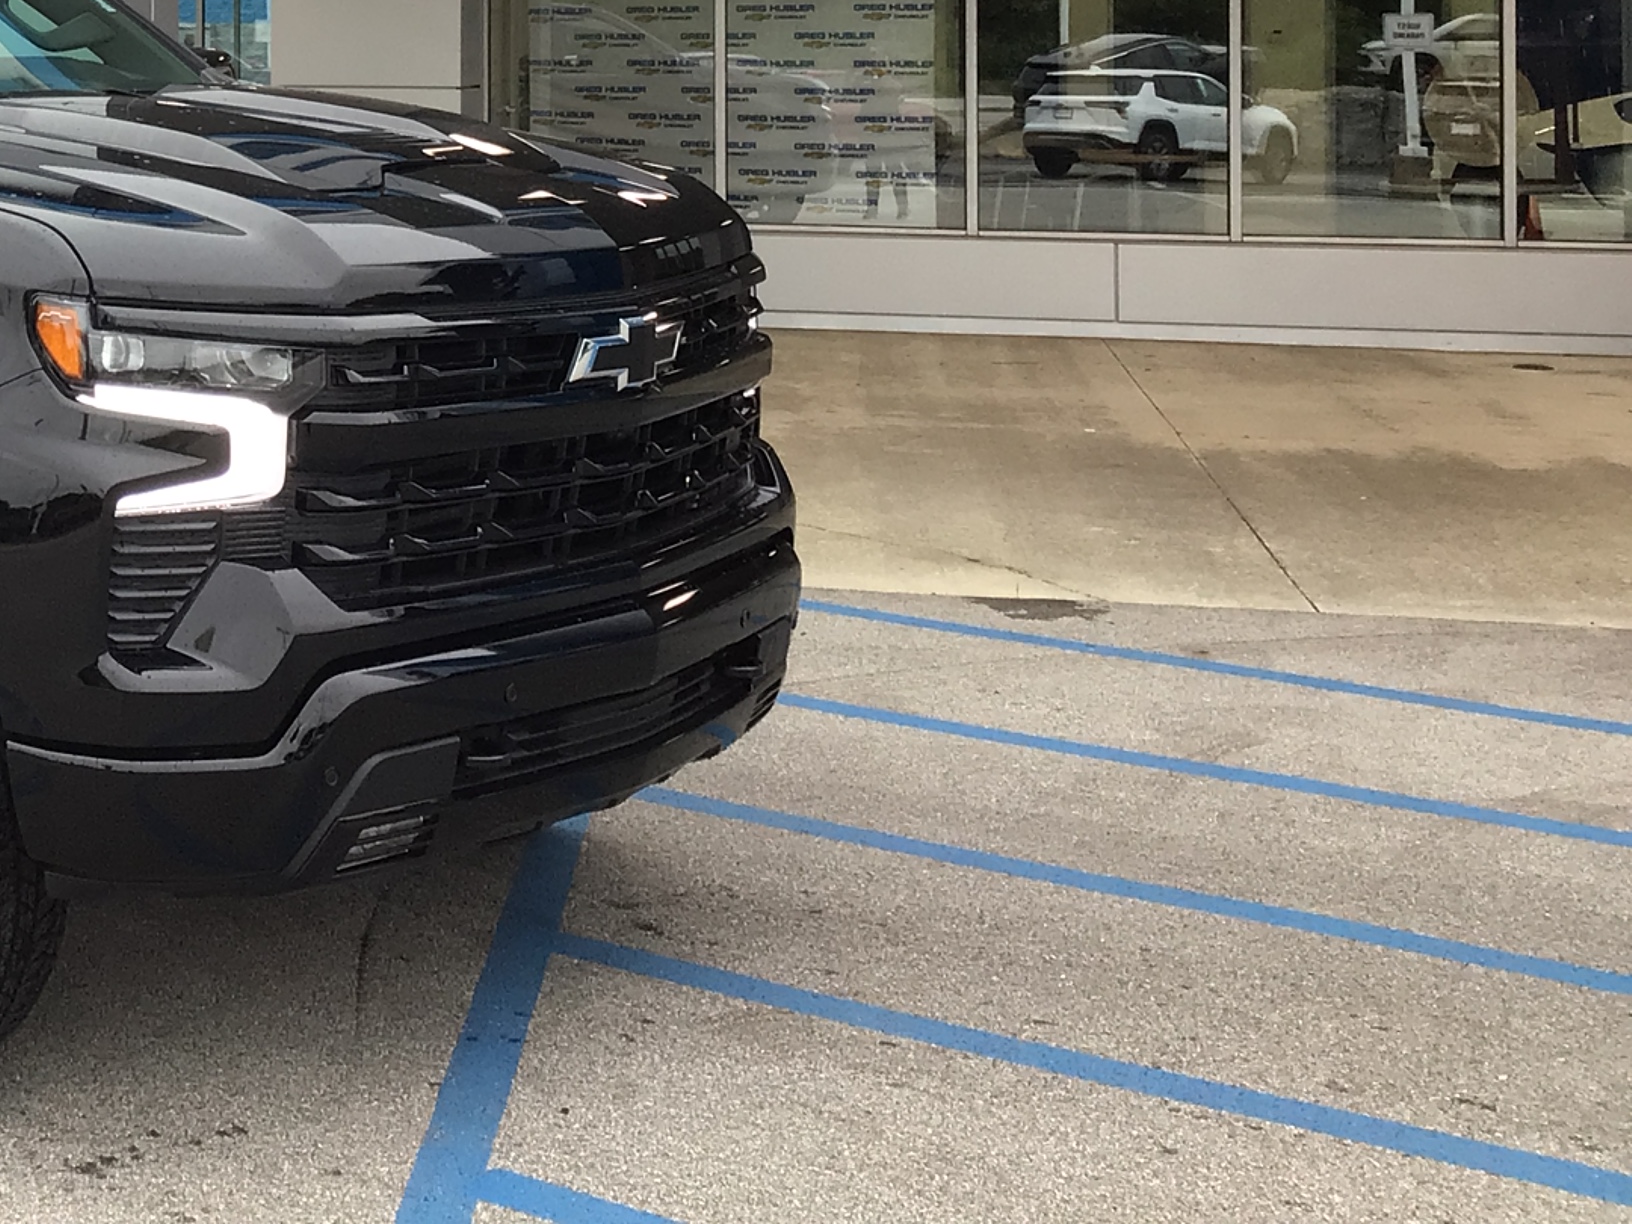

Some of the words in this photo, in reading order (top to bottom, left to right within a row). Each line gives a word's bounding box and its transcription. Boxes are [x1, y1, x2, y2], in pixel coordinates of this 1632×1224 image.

[736, 5, 766, 13] GREG
[770, 4, 814, 12] HUBLER
[854, 3, 885, 11] GREG
[727, 32, 757, 40] BLER
[854, 60, 885, 68] GREG
[771, 115, 815, 123] HUBLER
[727, 141, 756, 149] BLER
[829, 143, 875, 151] HUBLER
[772, 169, 816, 177] HUBLER
[856, 171, 887, 179] GREG
[727, 194, 759, 202] BLER
